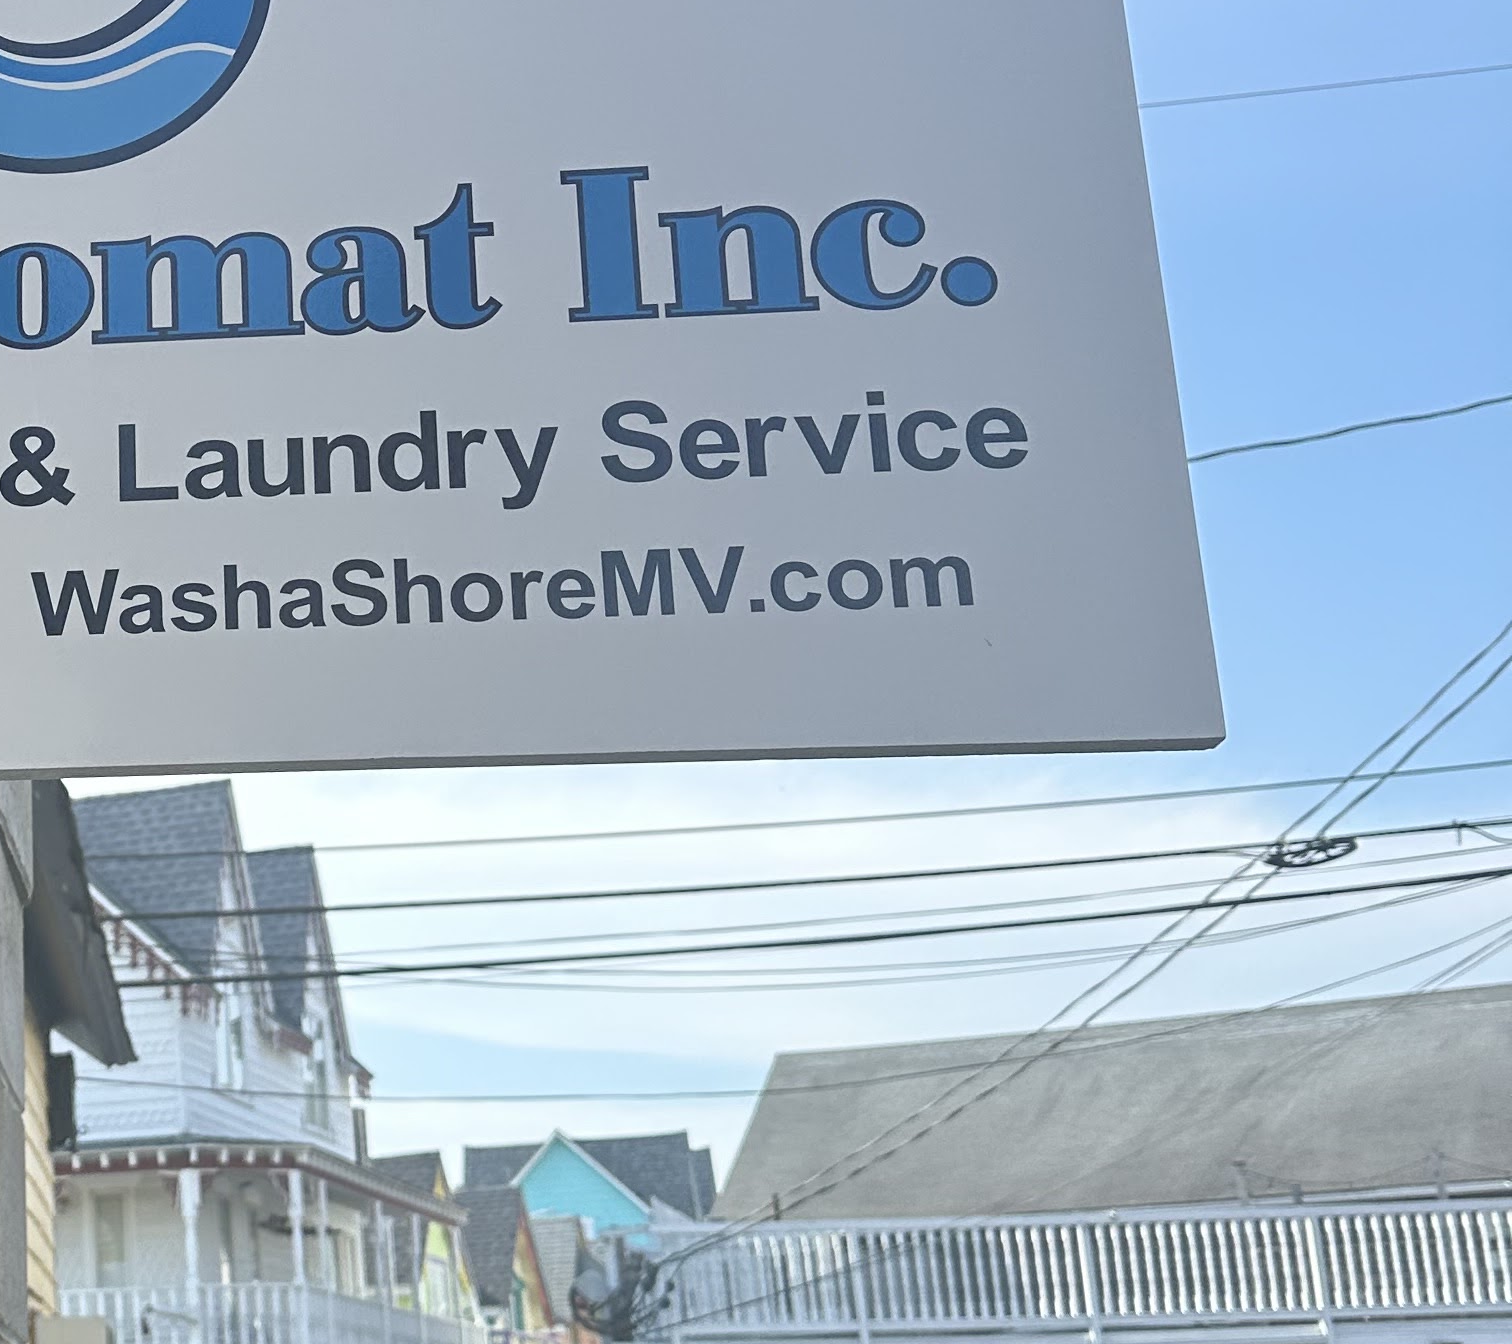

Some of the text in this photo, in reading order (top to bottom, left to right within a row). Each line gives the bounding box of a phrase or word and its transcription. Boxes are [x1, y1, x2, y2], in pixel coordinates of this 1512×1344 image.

[559, 165, 999, 324] Inc.
[117, 409, 559, 511] Laundry
[600, 390, 1029, 484] Service
[29, 545, 975, 637] WashaShoreMV.com
